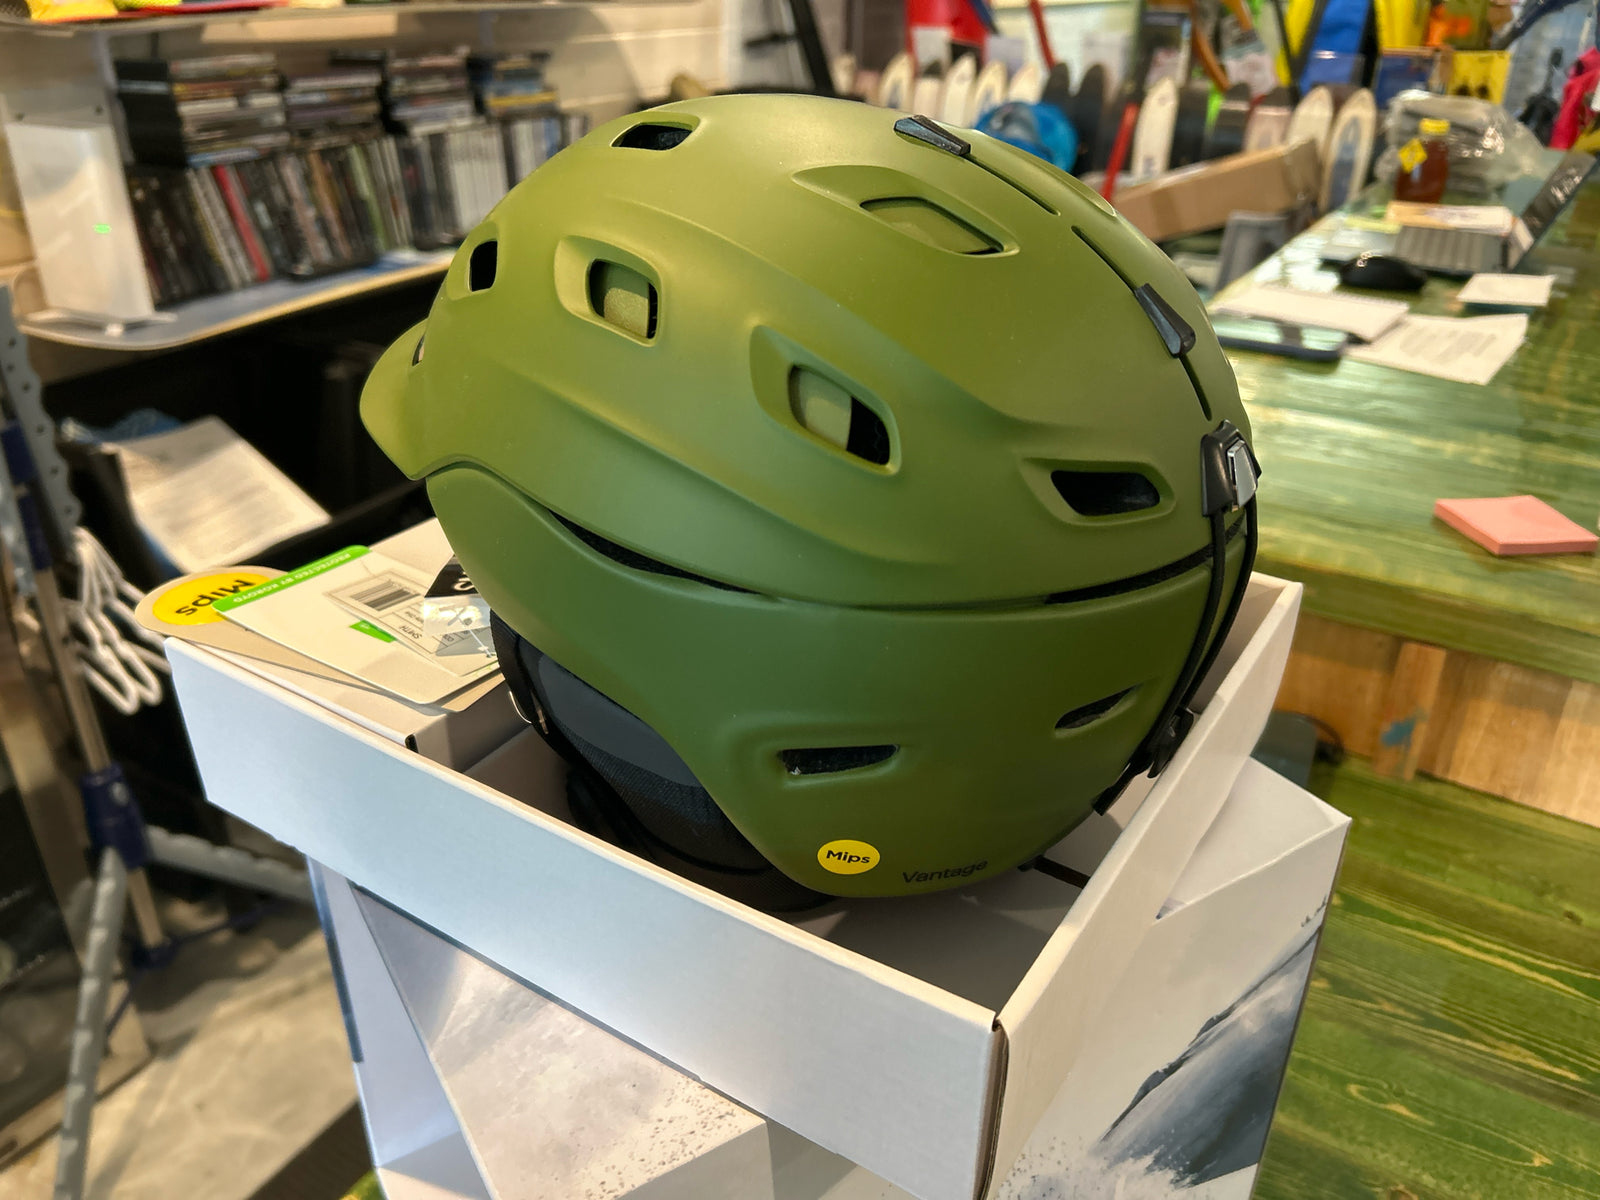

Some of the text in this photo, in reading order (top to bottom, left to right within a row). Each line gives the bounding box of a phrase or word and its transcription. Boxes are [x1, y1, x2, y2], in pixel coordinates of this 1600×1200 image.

[294, 553, 351, 579] PROTECTED
[175, 579, 254, 616] Mips
[399, 624, 422, 640] SMITH
[825, 850, 871, 864] Mips
[902, 859, 989, 883] Vantage
